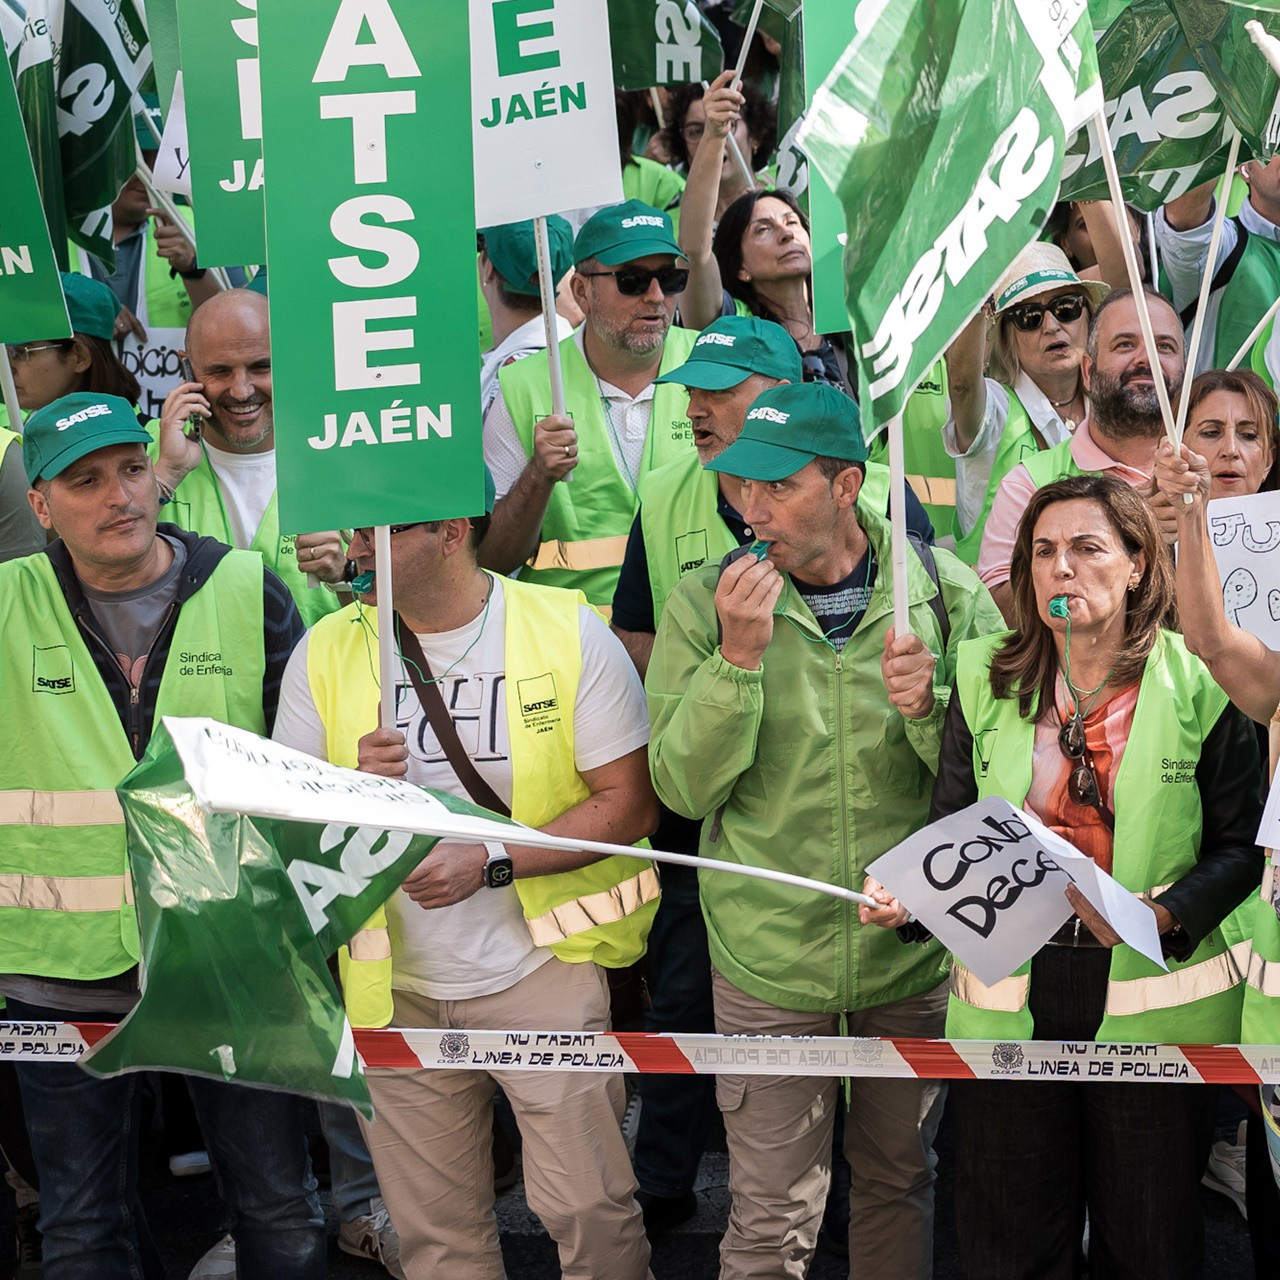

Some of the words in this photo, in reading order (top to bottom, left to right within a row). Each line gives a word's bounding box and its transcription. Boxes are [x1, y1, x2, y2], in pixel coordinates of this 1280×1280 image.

[480, 80, 588, 128] JAÉN
[621, 215, 664, 228] SATSE
[695, 333, 736, 347] SATSE
[55, 404, 112, 431] SATSE
[747, 406, 790, 425] SATSE
[307, 400, 452, 451] JAÉN
[180, 665, 194, 676] de
[37, 677, 71, 689] SATSE
[523, 698, 558, 713] SATSE
[523, 715, 549, 723] Sindicato
[536, 726, 554, 734] JAÉN
[1161, 772, 1174, 783] de
[18, 1042, 85, 1056] POLICIA
[470, 1050, 522, 1065] LINEA
[528, 1051, 554, 1066] DE
[560, 1052, 624, 1067] POLICIA
[1027, 1060, 1080, 1075] LINEA
[1088, 1061, 1115, 1076] DE
[1120, 1062, 1189, 1077] POLICIA
